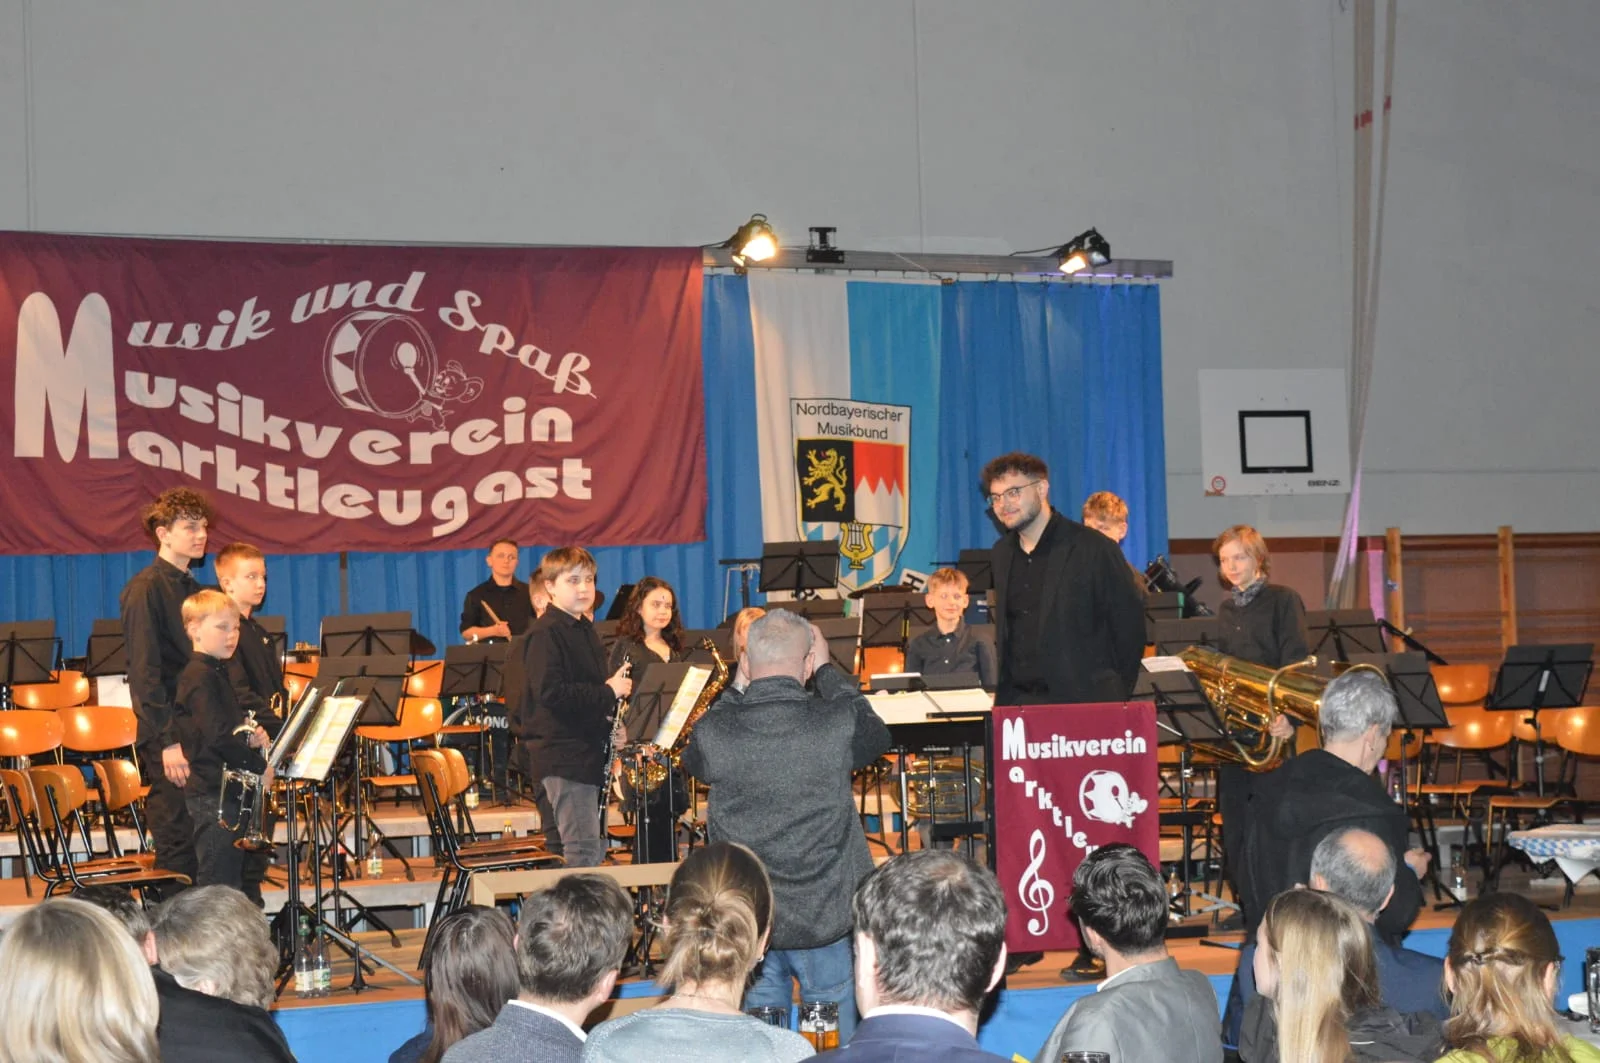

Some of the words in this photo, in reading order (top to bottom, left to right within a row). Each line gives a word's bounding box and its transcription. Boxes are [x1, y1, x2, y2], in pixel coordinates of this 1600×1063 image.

[291, 271, 425, 324] und
[439, 290, 597, 399] Spaß
[796, 403, 903, 422] Nordbayerischer
[817, 422, 888, 440] Musikbund
